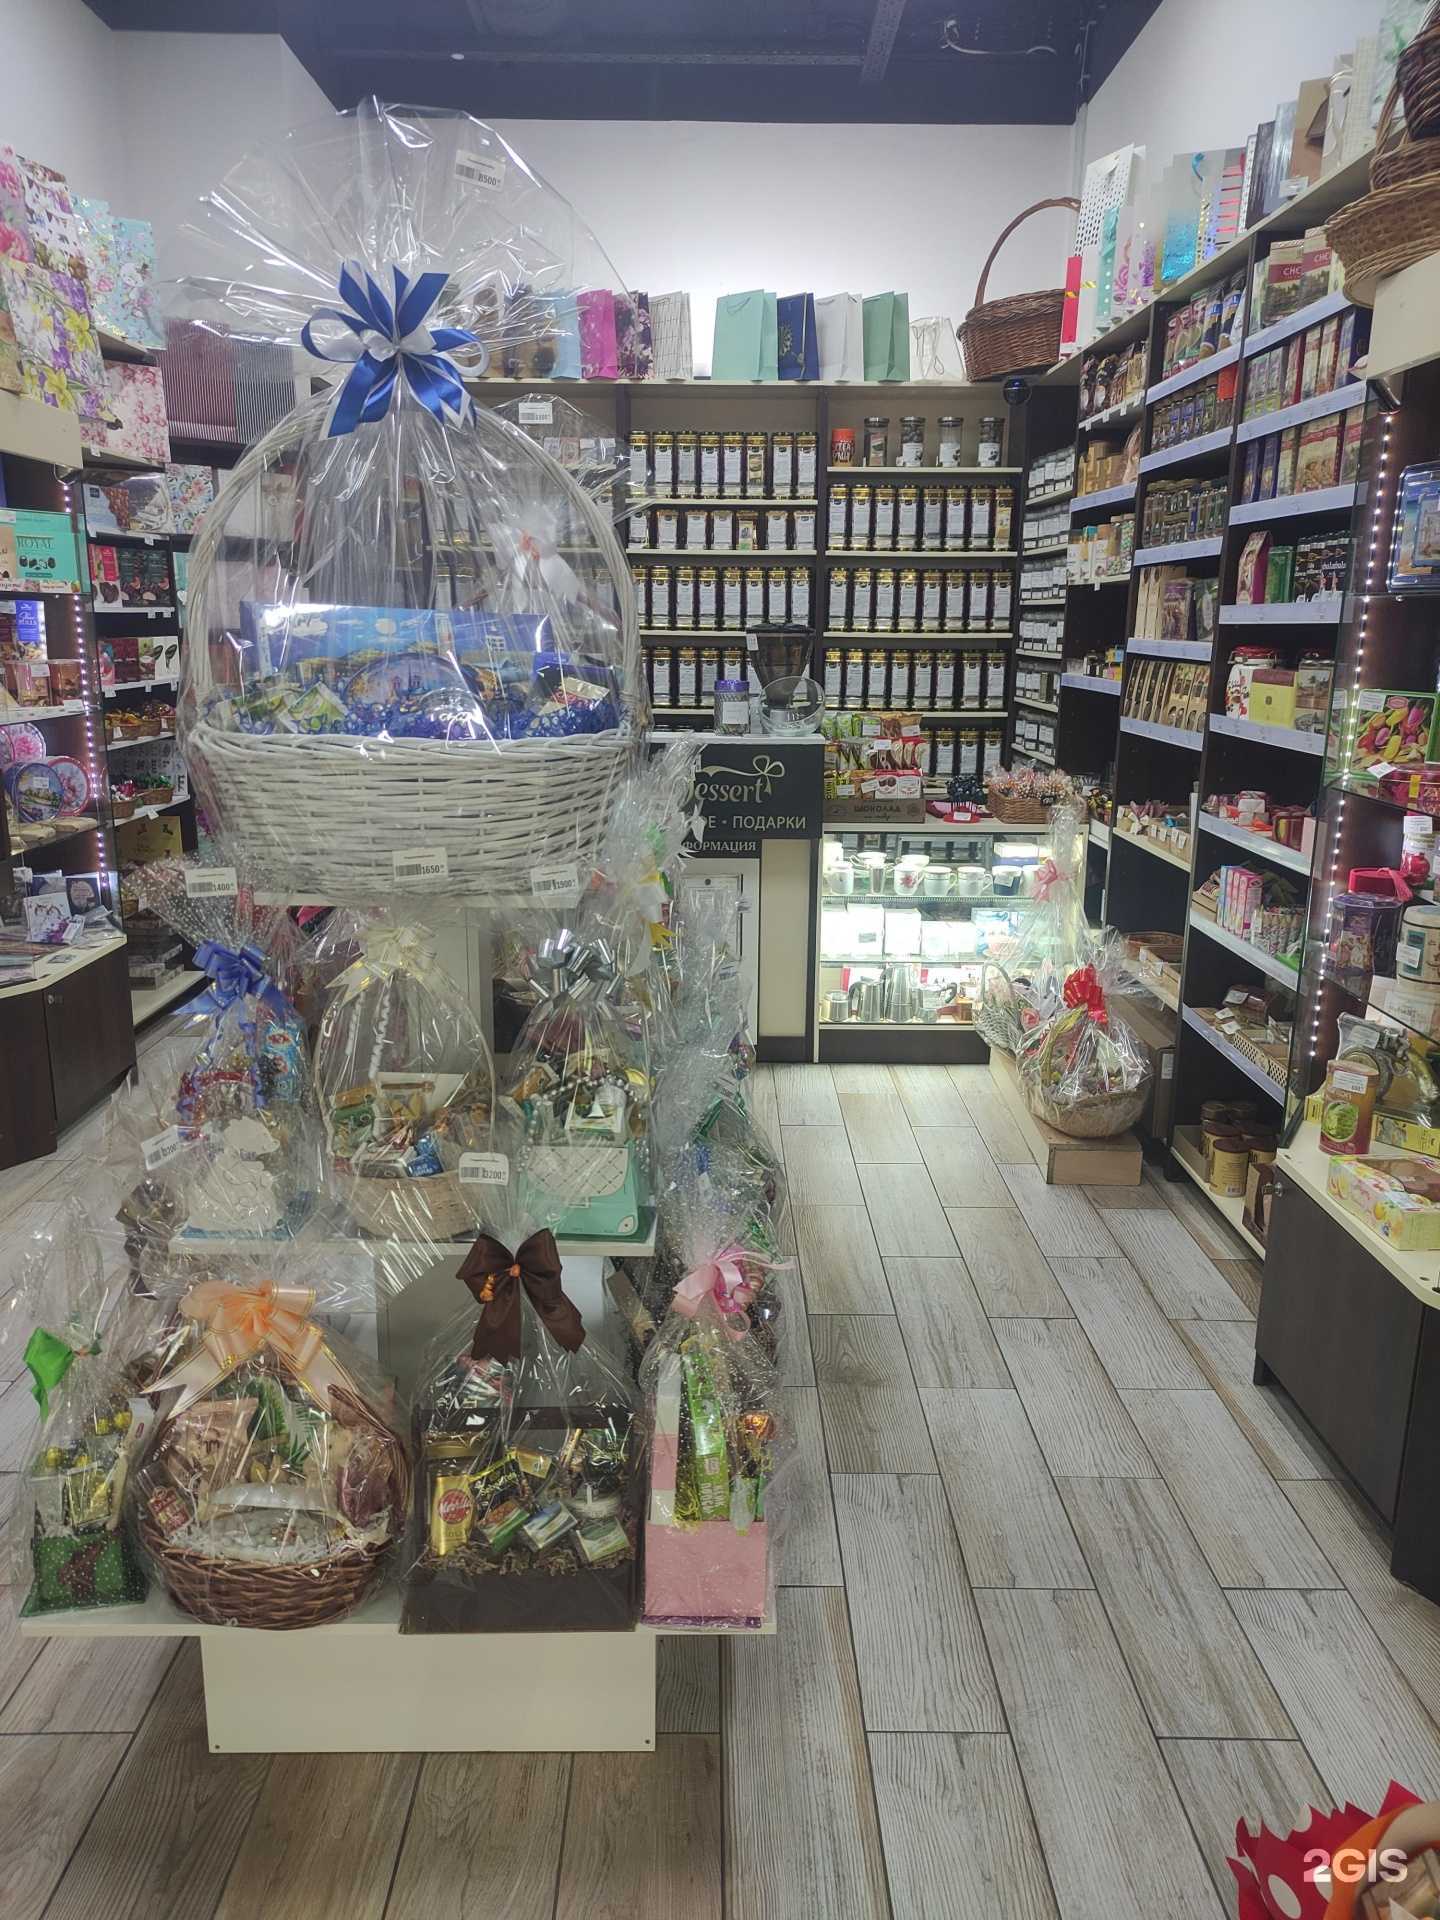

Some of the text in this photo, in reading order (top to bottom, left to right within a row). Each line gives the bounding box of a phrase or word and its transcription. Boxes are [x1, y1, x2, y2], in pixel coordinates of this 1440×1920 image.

[732, 815, 807, 831] ПОДАРКИ
[682, 840, 757, 853] ФОРМАЦИЯ
[422, 864, 441, 874] 1650
